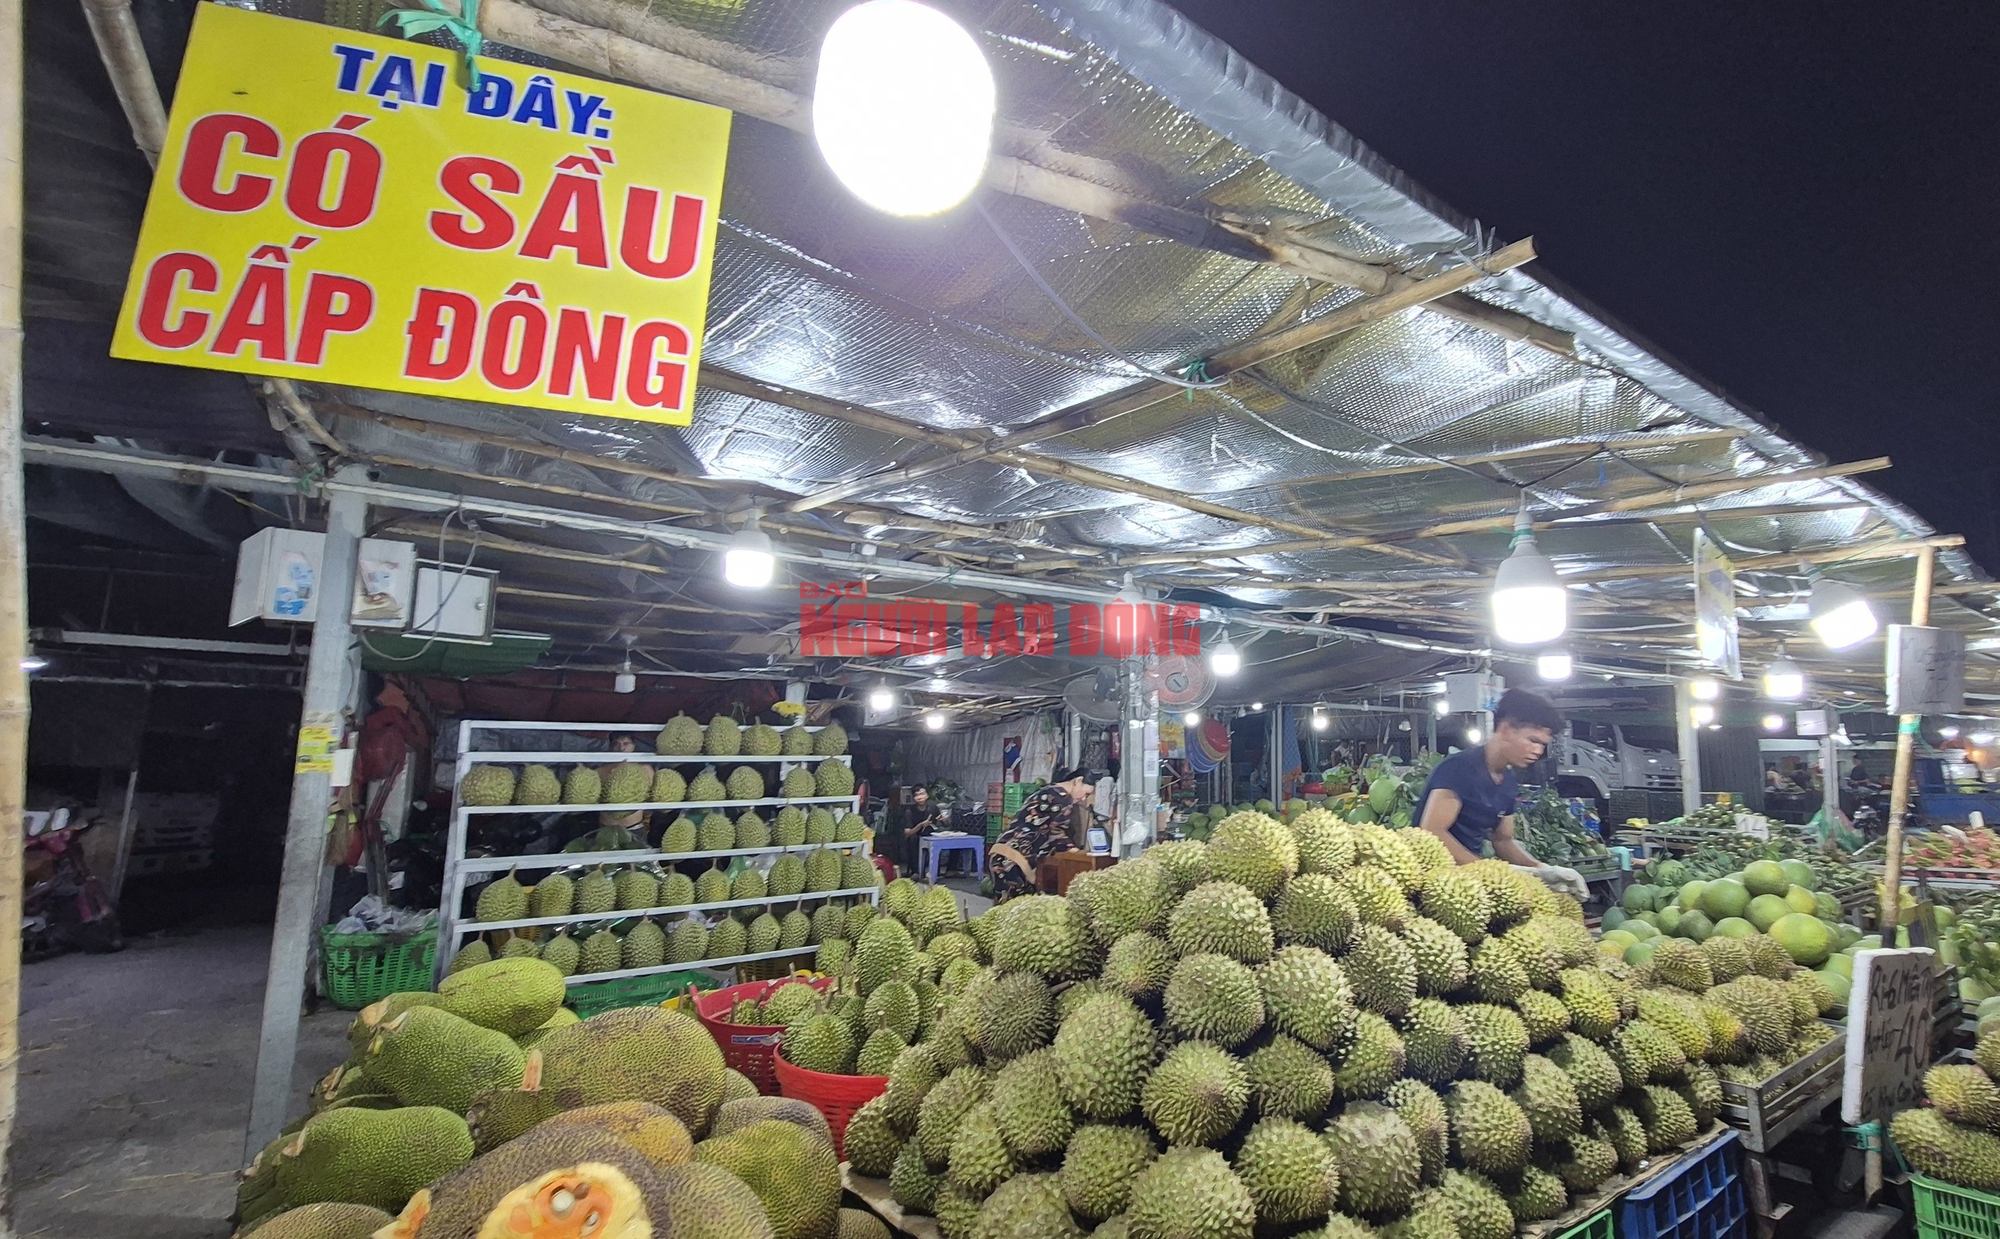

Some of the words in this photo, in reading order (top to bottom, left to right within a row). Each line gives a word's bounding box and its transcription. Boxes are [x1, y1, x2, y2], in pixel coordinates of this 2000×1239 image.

[332, 44, 445, 110] TẠI
[468, 75, 613, 139] ĐÂY:
[178, 113, 382, 229] CÓ
[429, 146, 704, 279] SẦU
[137, 236, 375, 365] CẤP
[404, 282, 691, 411] ĐÔNG
